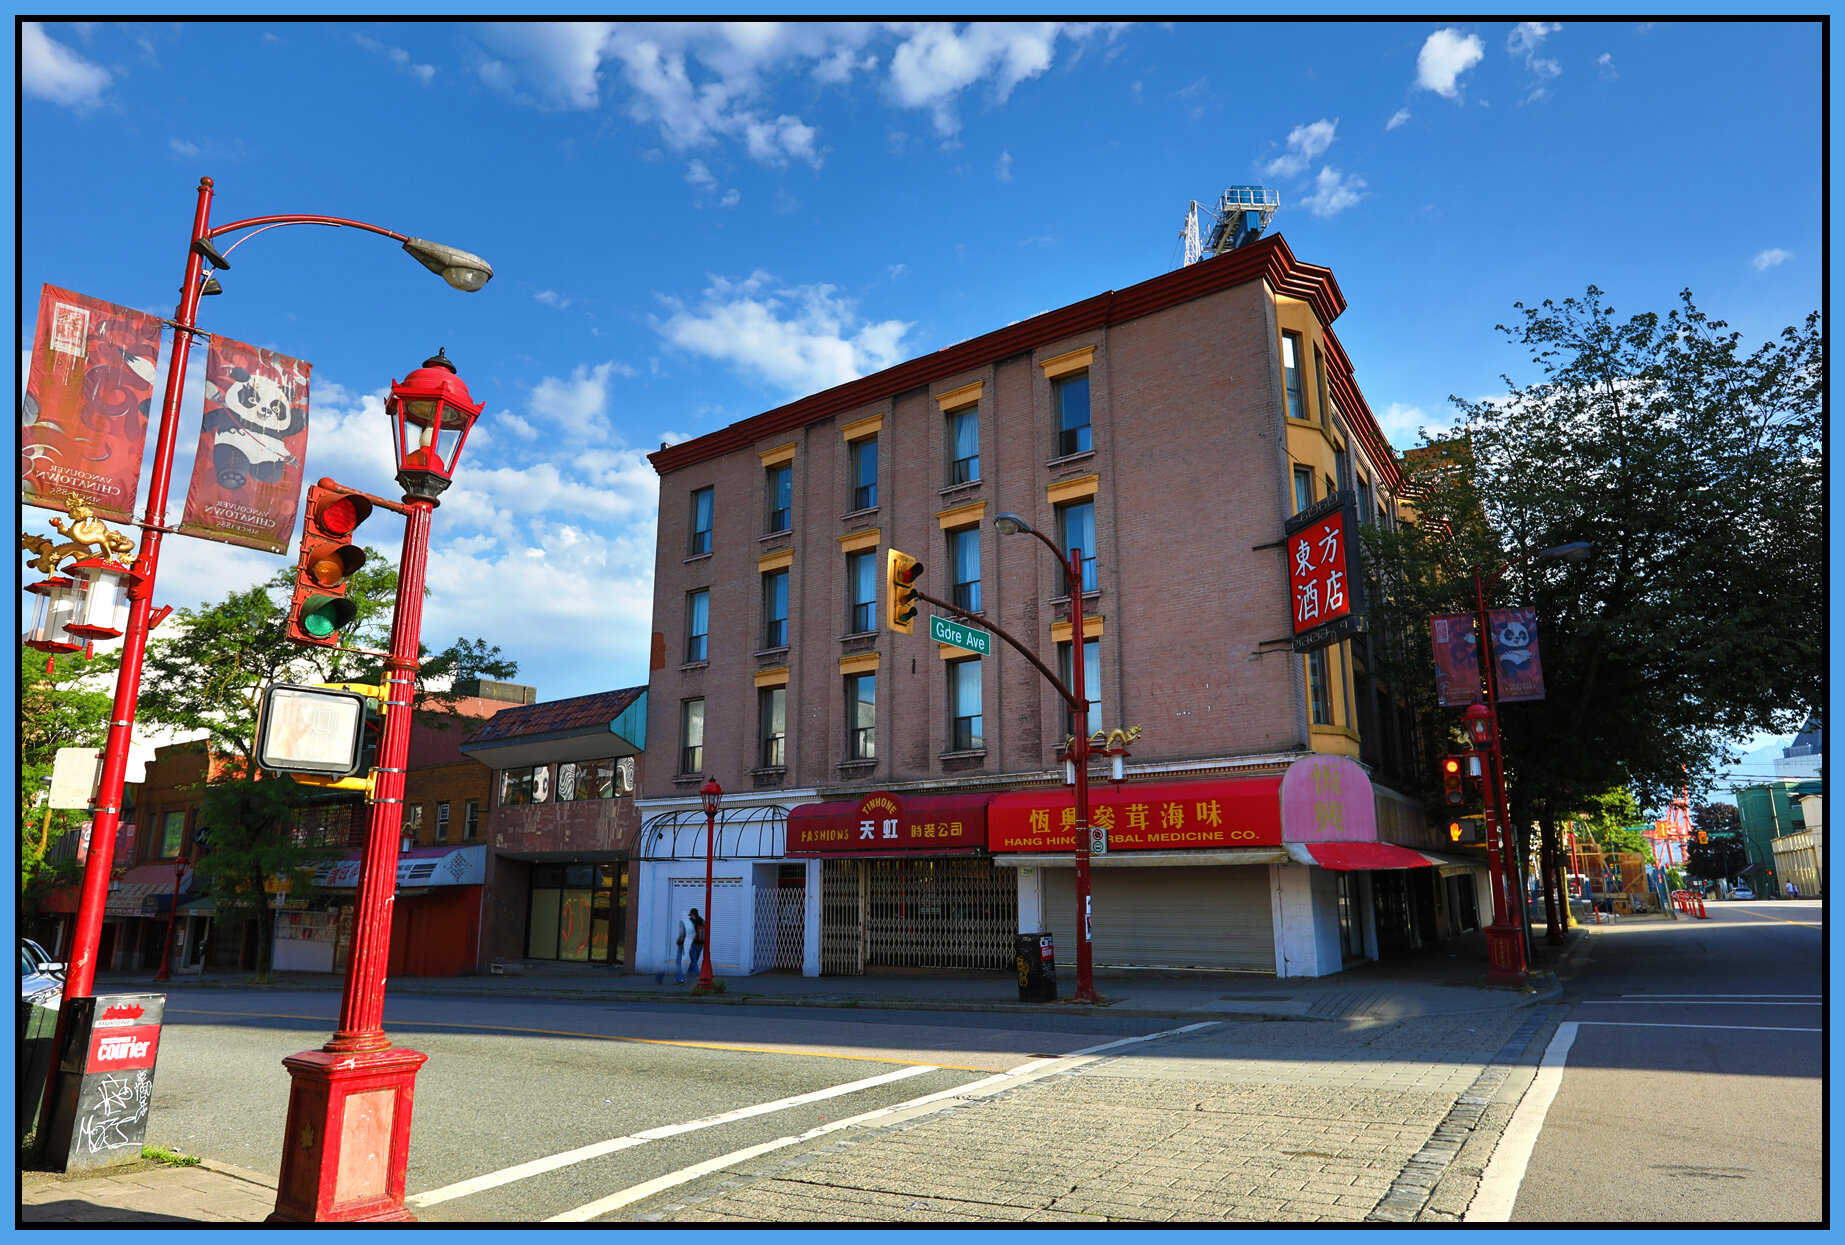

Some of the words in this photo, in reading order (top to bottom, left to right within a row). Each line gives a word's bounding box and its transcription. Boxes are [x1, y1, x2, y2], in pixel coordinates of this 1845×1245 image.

[1295, 526, 1340, 577] 東方
[1296, 570, 1344, 623] 酒店
[936, 622, 962, 644] Gore
[966, 631, 985, 650] Ave
[861, 797, 898, 815] TINHONE
[801, 828, 849, 843] FASHIONS
[860, 818, 899, 840] 天虹
[1004, 837, 1043, 847] HANG
[1107, 833, 1144, 844] RBAL
[1147, 831, 1224, 842] MEDICINE
[1230, 830, 1261, 841] CO.
[97, 1041, 151, 1061] courier
